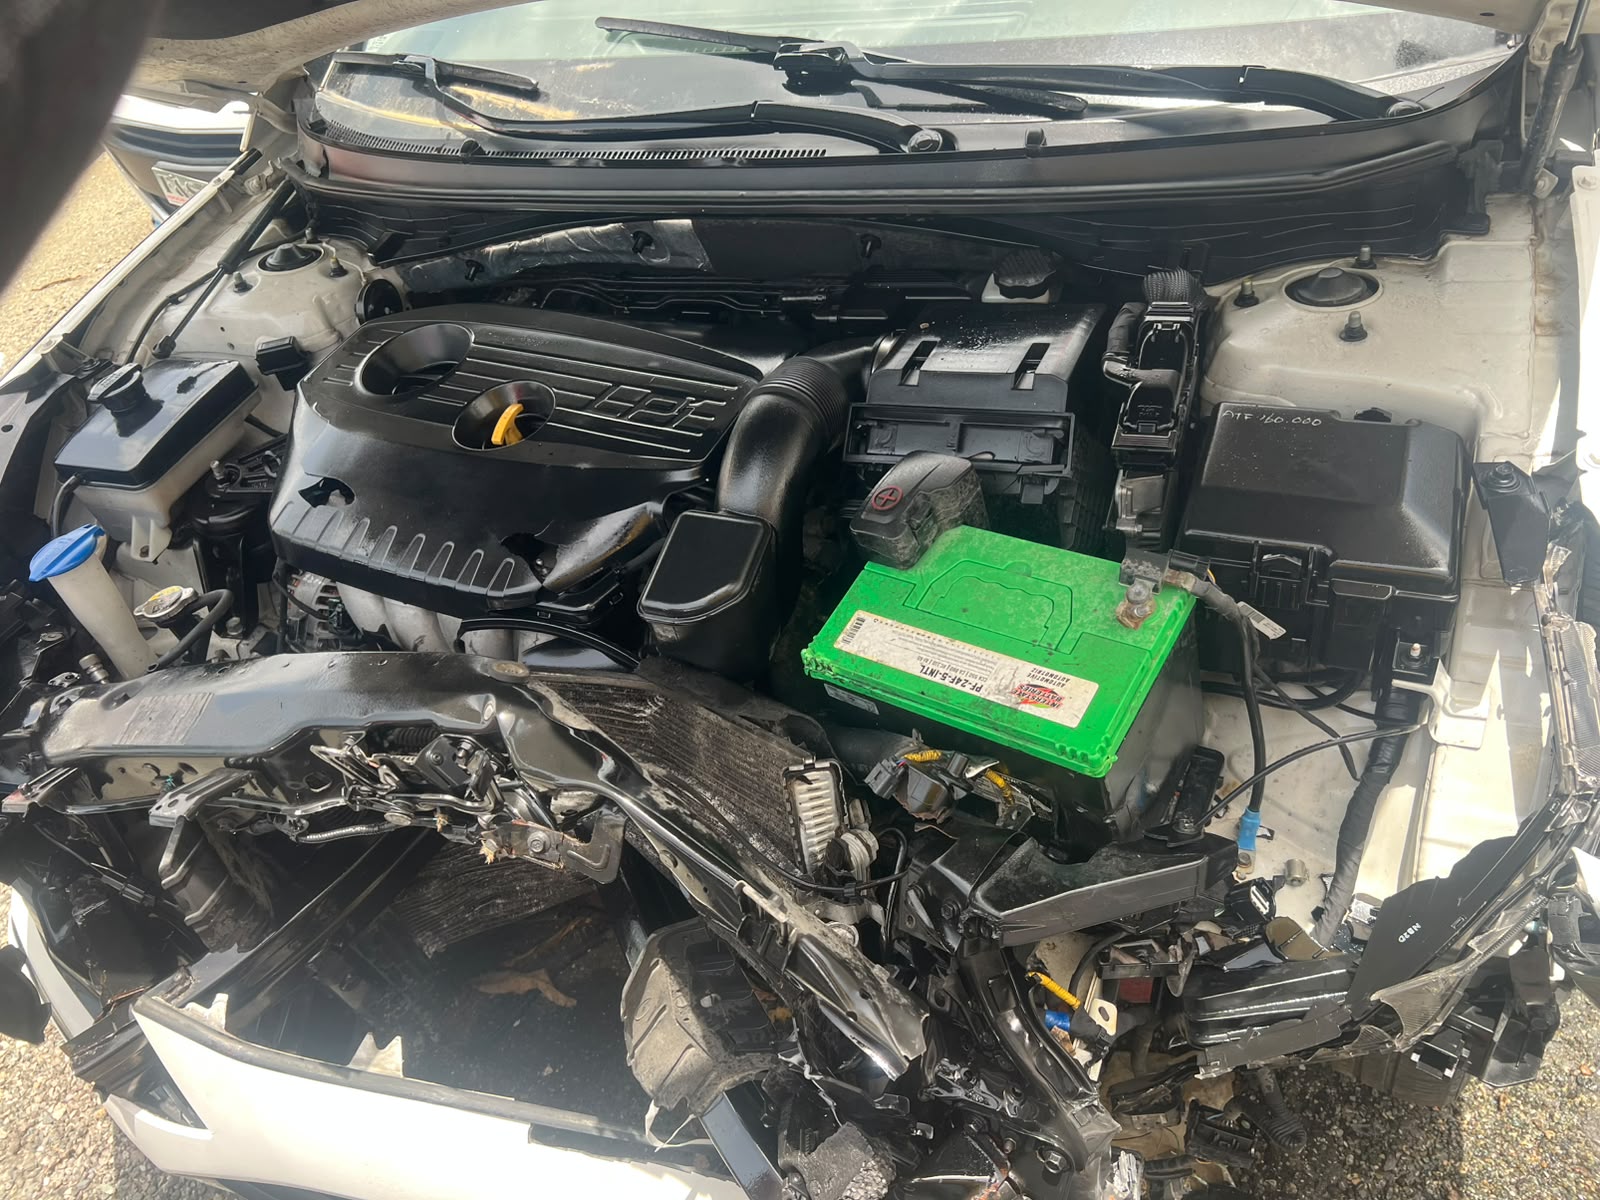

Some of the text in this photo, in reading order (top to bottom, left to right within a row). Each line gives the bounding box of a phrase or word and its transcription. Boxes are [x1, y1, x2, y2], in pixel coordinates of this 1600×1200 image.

[919, 665, 983, 693] PF-24F-5-INTL
[1026, 672, 1065, 688] AUTOMOTIVE
[1010, 688, 1061, 709] INTERSTATE
[1018, 684, 1063, 702] BATTERIES
